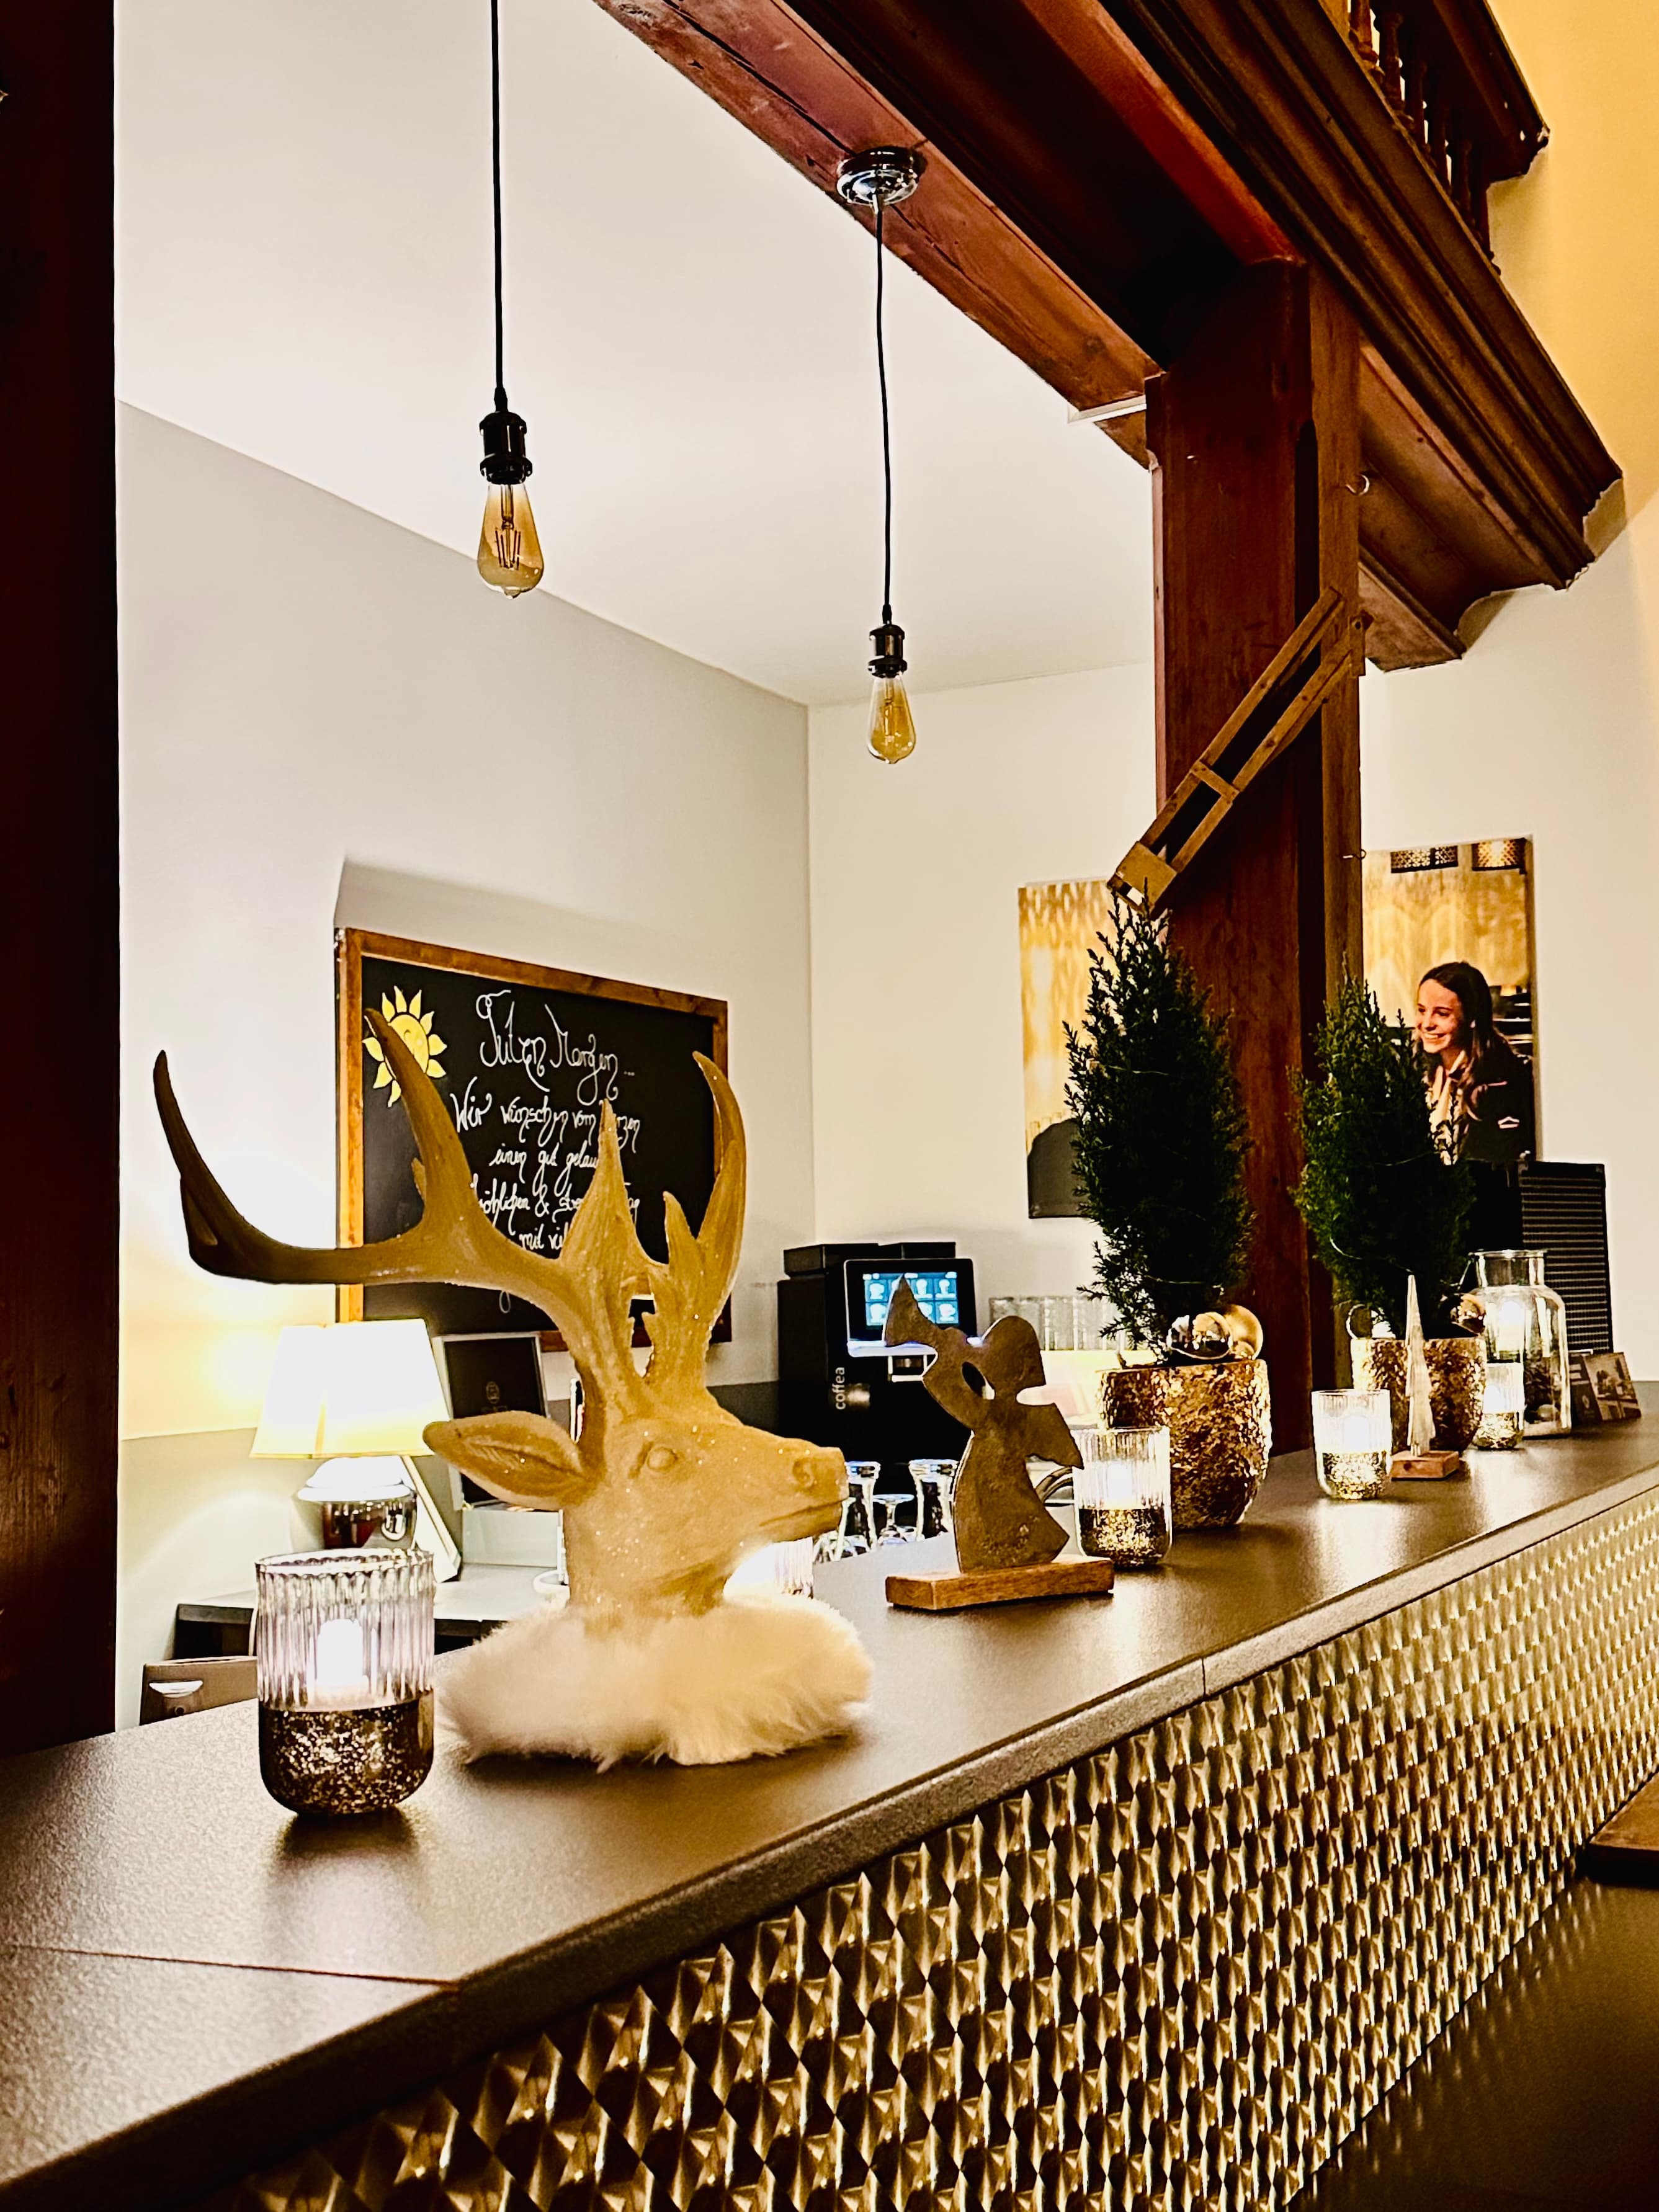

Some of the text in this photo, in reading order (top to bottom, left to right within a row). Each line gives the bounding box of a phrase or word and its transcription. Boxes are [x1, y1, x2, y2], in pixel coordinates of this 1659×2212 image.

[544, 1003, 619, 1105] Morgen
[449, 1076, 492, 1133] Wir
[488, 1139, 600, 1198] einen gut gelau
[534, 1184, 550, 1218] &
[519, 1223, 545, 1251] mit
[831, 1367, 846, 1410] coffea
